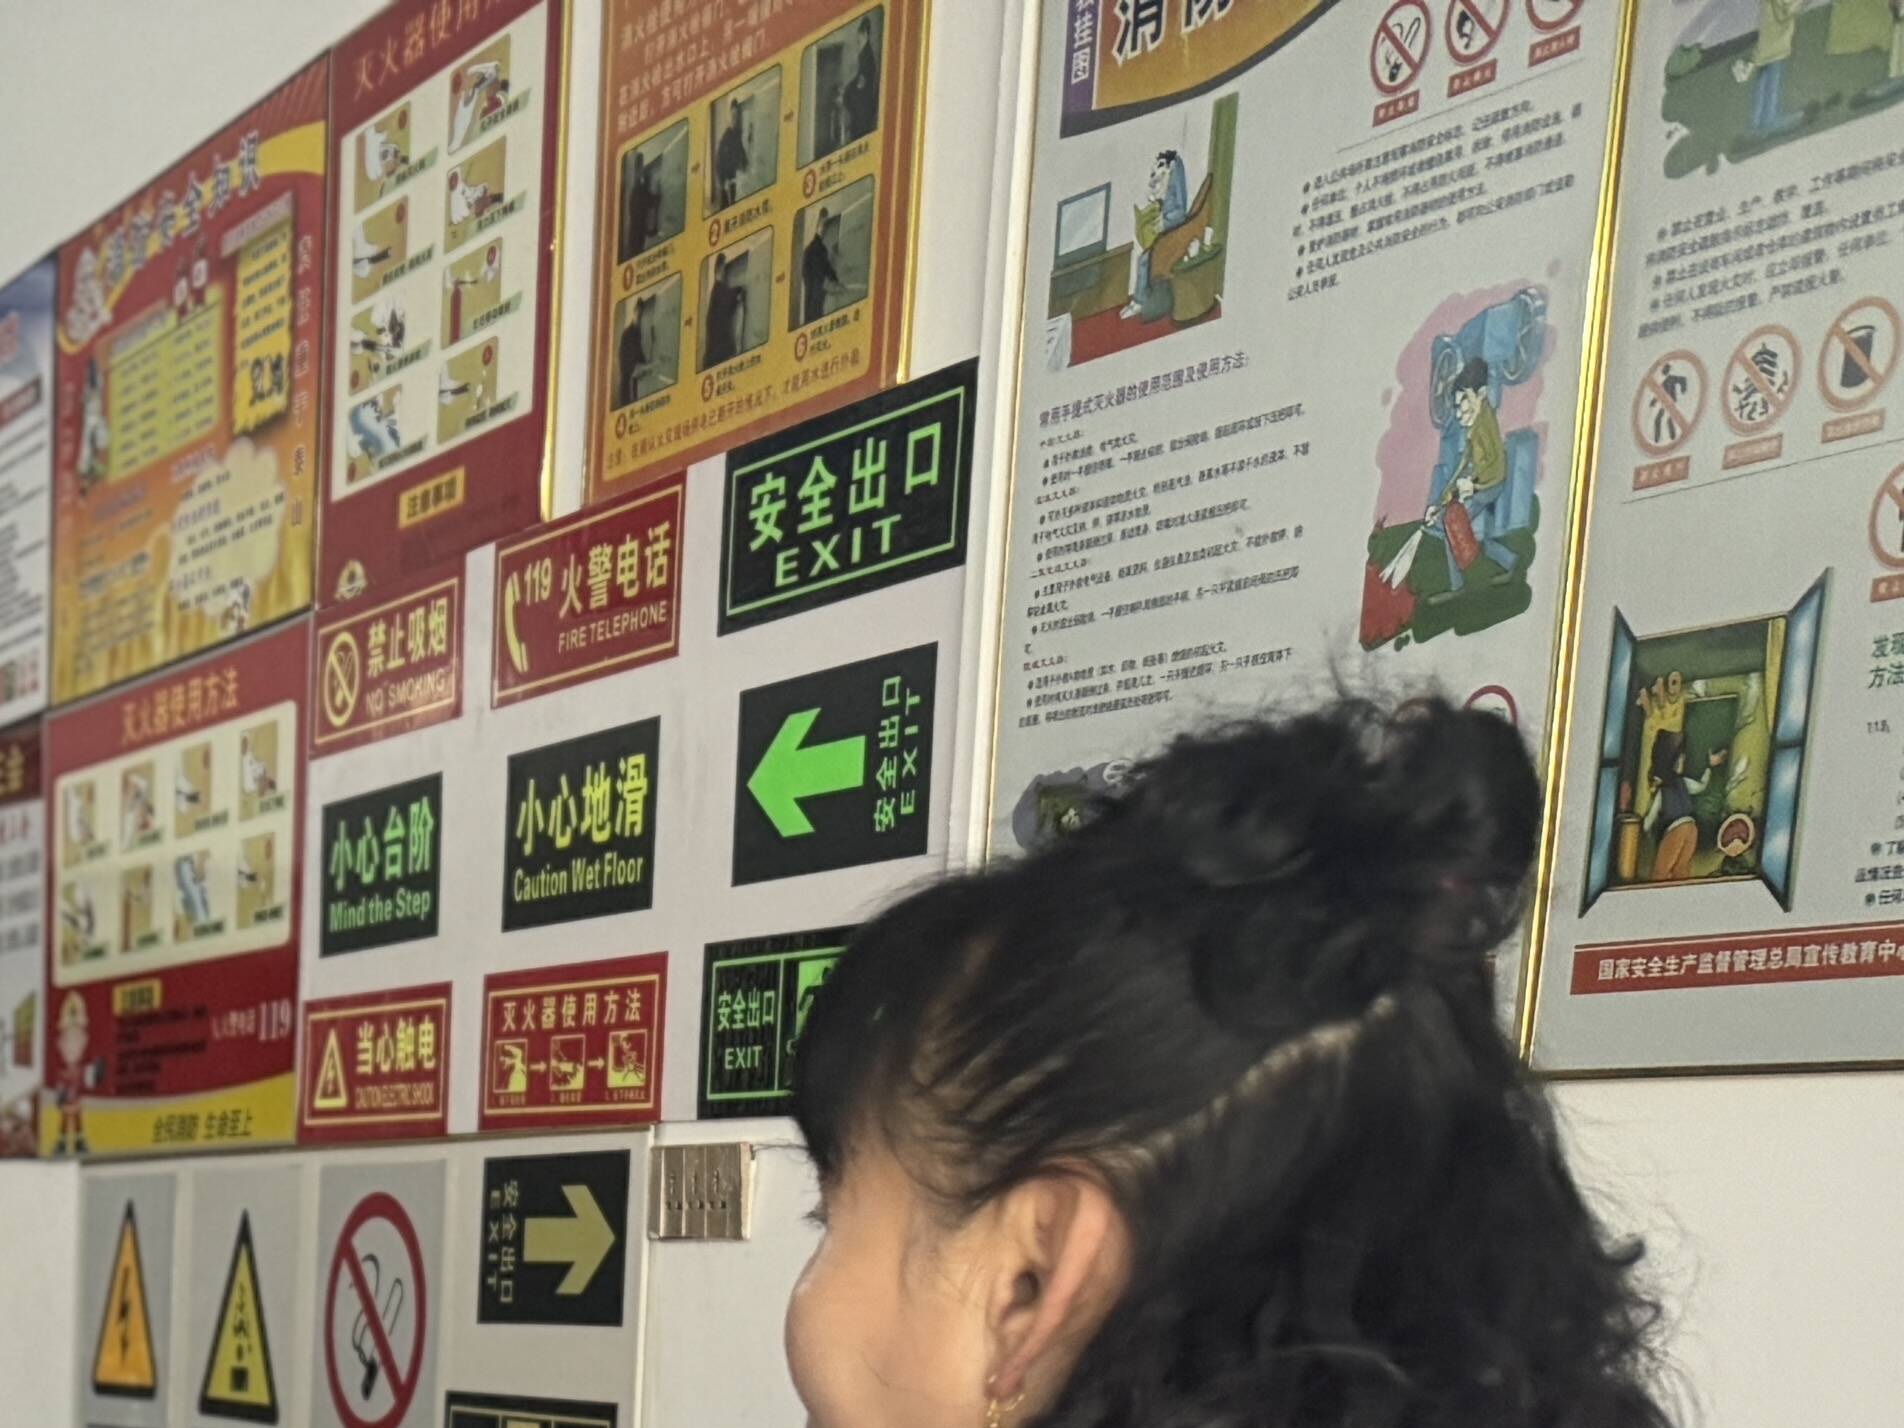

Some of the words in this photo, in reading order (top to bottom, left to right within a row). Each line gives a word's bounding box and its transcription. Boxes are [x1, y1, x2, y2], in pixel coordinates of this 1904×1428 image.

[1072, 0, 1095, 82] 挂图
[748, 421, 942, 552] 安全出口
[523, 557, 552, 601] 119
[559, 520, 671, 618] 火警电话
[775, 514, 903, 589] EXIT
[367, 597, 448, 679] 禁止吸烟
[559, 625, 587, 655] FIRE
[589, 599, 667, 646] TELEPHONE
[366, 690, 384, 717] NO
[388, 668, 445, 707] SMOKING
[873, 675, 902, 832] 安全出口
[899, 689, 921, 816] EXIT
[329, 795, 435, 892] 小心台阶
[516, 752, 648, 857] 小心地滑
[329, 896, 366, 933] Mind
[368, 892, 392, 924] the
[395, 886, 431, 926] Step
[514, 863, 569, 903] Caution
[571, 855, 601, 892] Wet
[603, 852, 645, 888] Floor
[355, 1014, 437, 1076] 当心触电
[501, 988, 642, 1033] 灭火器使用方法
[717, 987, 775, 1033] 安全出口
[724, 1044, 762, 1070] EXIT
[486, 1190, 501, 1292] EXIT
[500, 1179, 520, 1304] 安全出口
